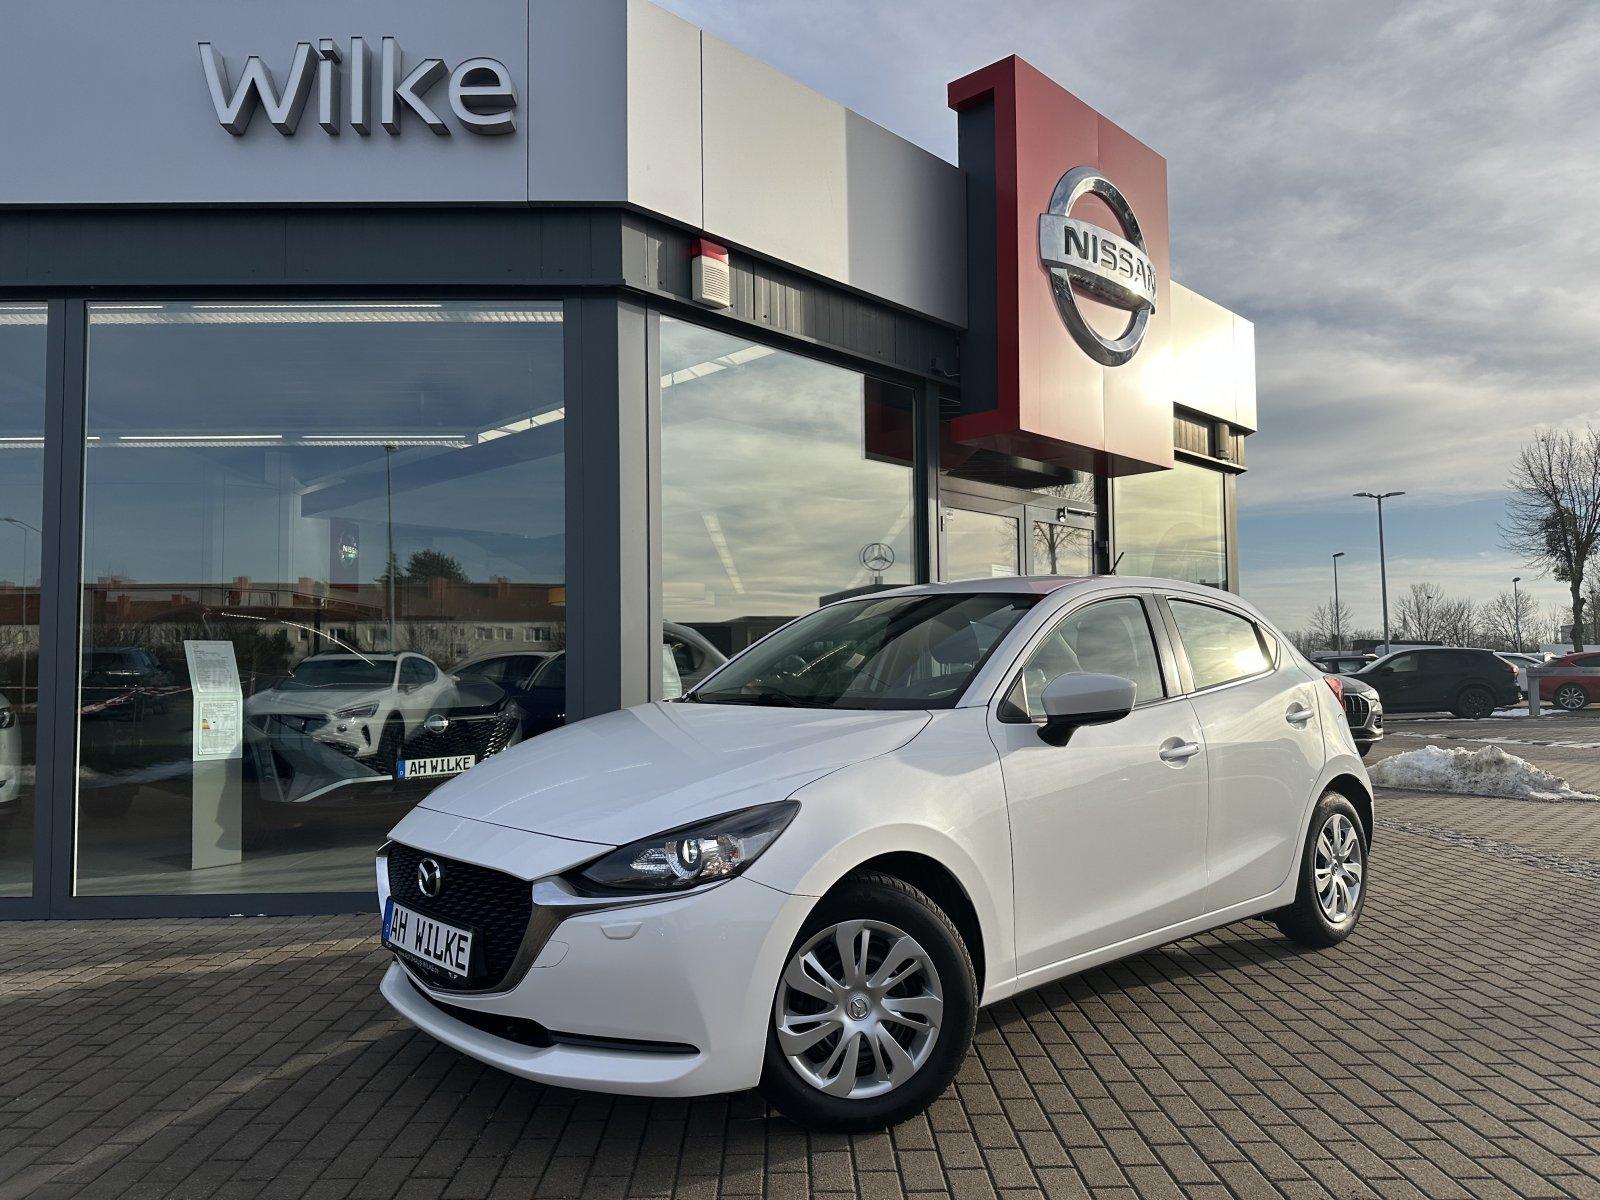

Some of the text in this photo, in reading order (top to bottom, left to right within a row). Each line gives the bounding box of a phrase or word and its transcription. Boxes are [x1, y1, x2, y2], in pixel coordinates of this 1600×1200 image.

[198, 36, 517, 136] Wilke
[1064, 225, 1156, 298] NISSAN
[409, 761, 427, 775] AH
[430, 757, 471, 773] WILKE
[390, 907, 408, 944] AH
[415, 917, 469, 971] WILKE
